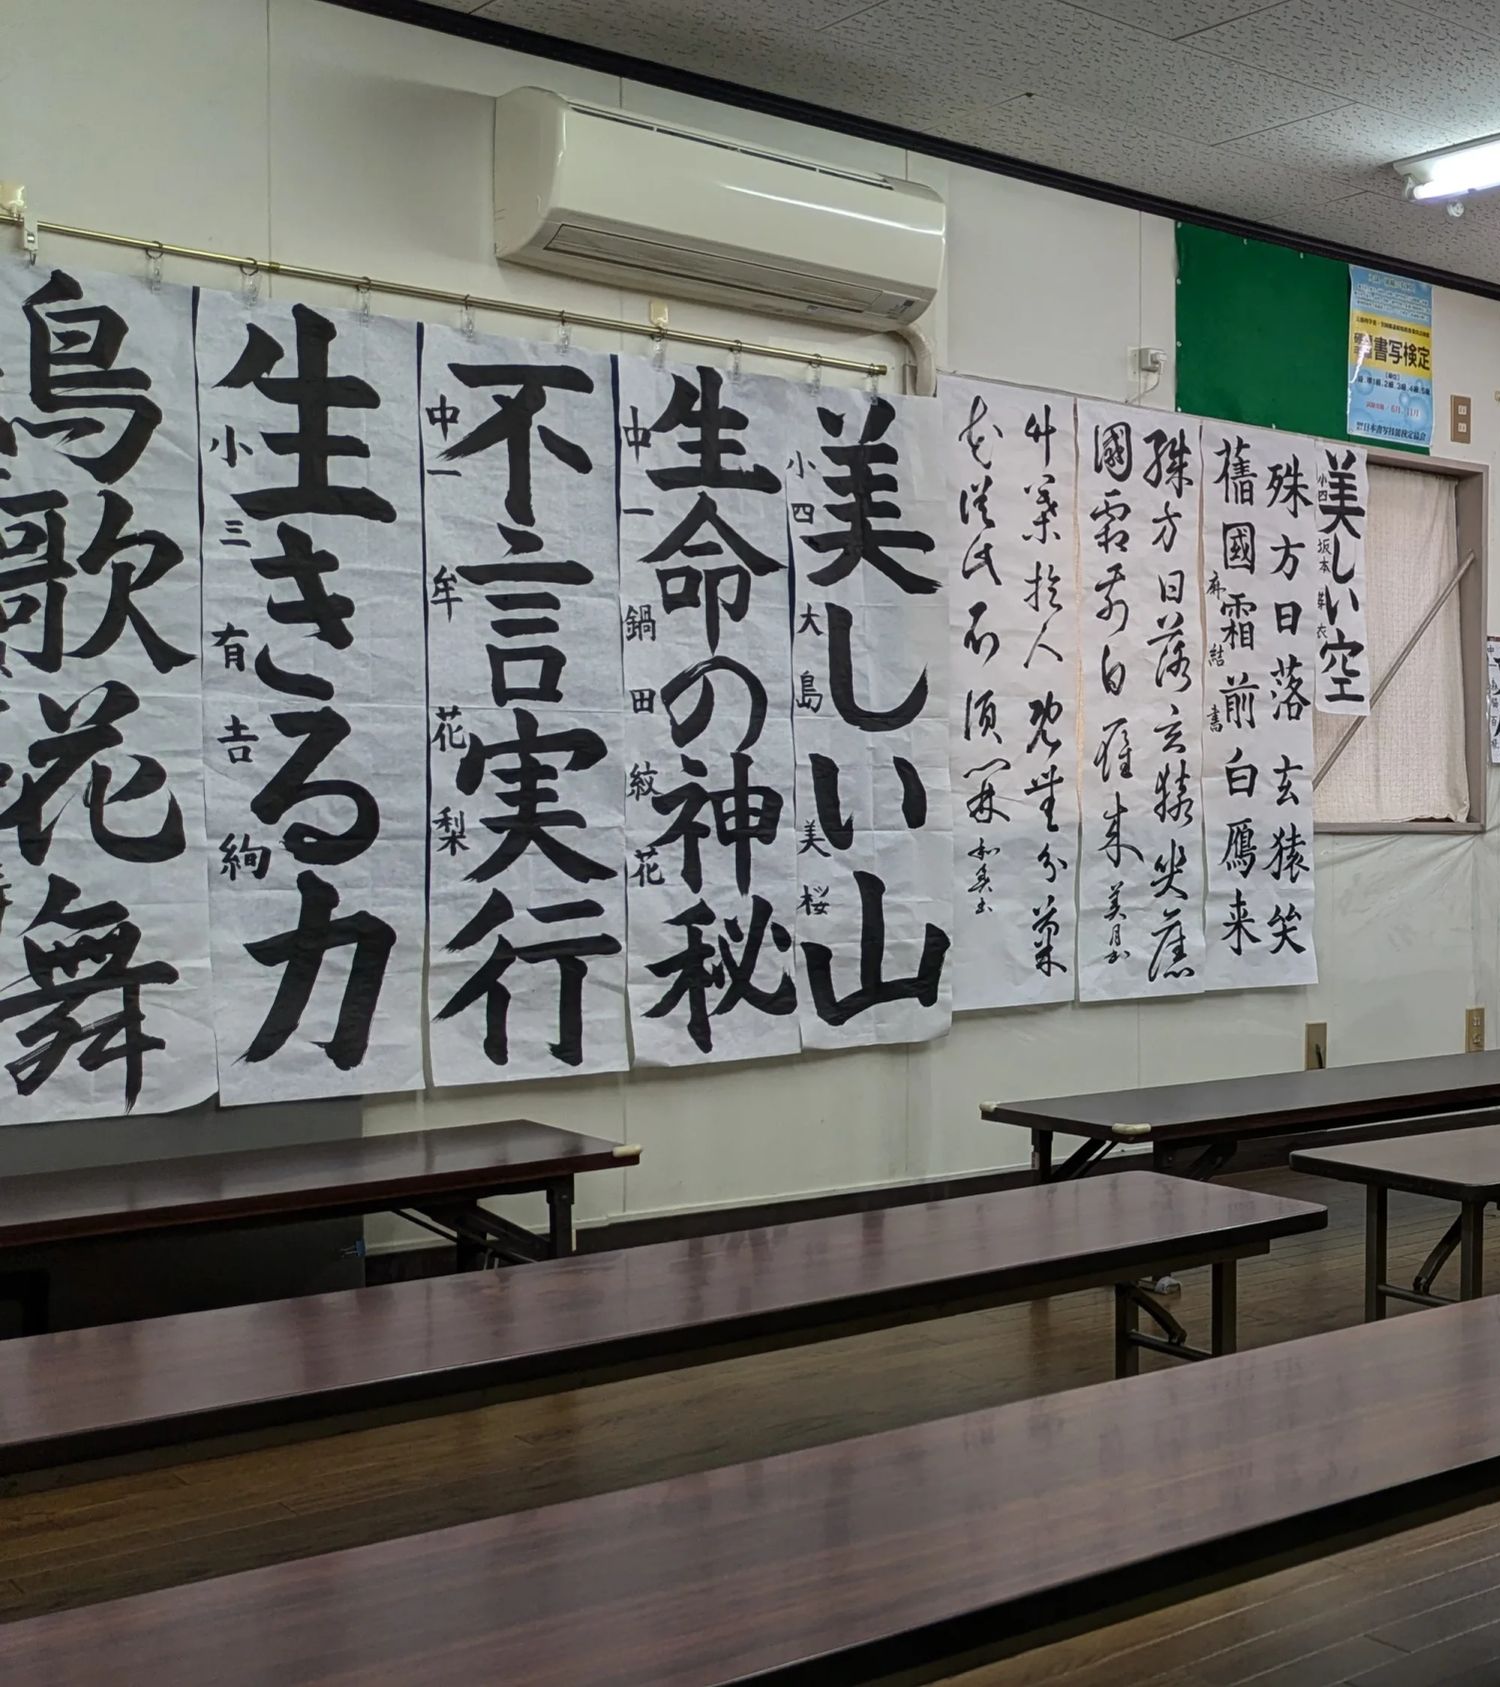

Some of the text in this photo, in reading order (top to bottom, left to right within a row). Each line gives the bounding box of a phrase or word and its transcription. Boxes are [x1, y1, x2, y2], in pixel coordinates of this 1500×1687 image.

[212, 304, 397, 1070] 生きる力
[432, 362, 620, 1068] 不言実行
[640, 366, 798, 1054] 生命の神秘
[801, 397, 951, 1027] 美しい山
[1318, 449, 1366, 703] 美しい空
